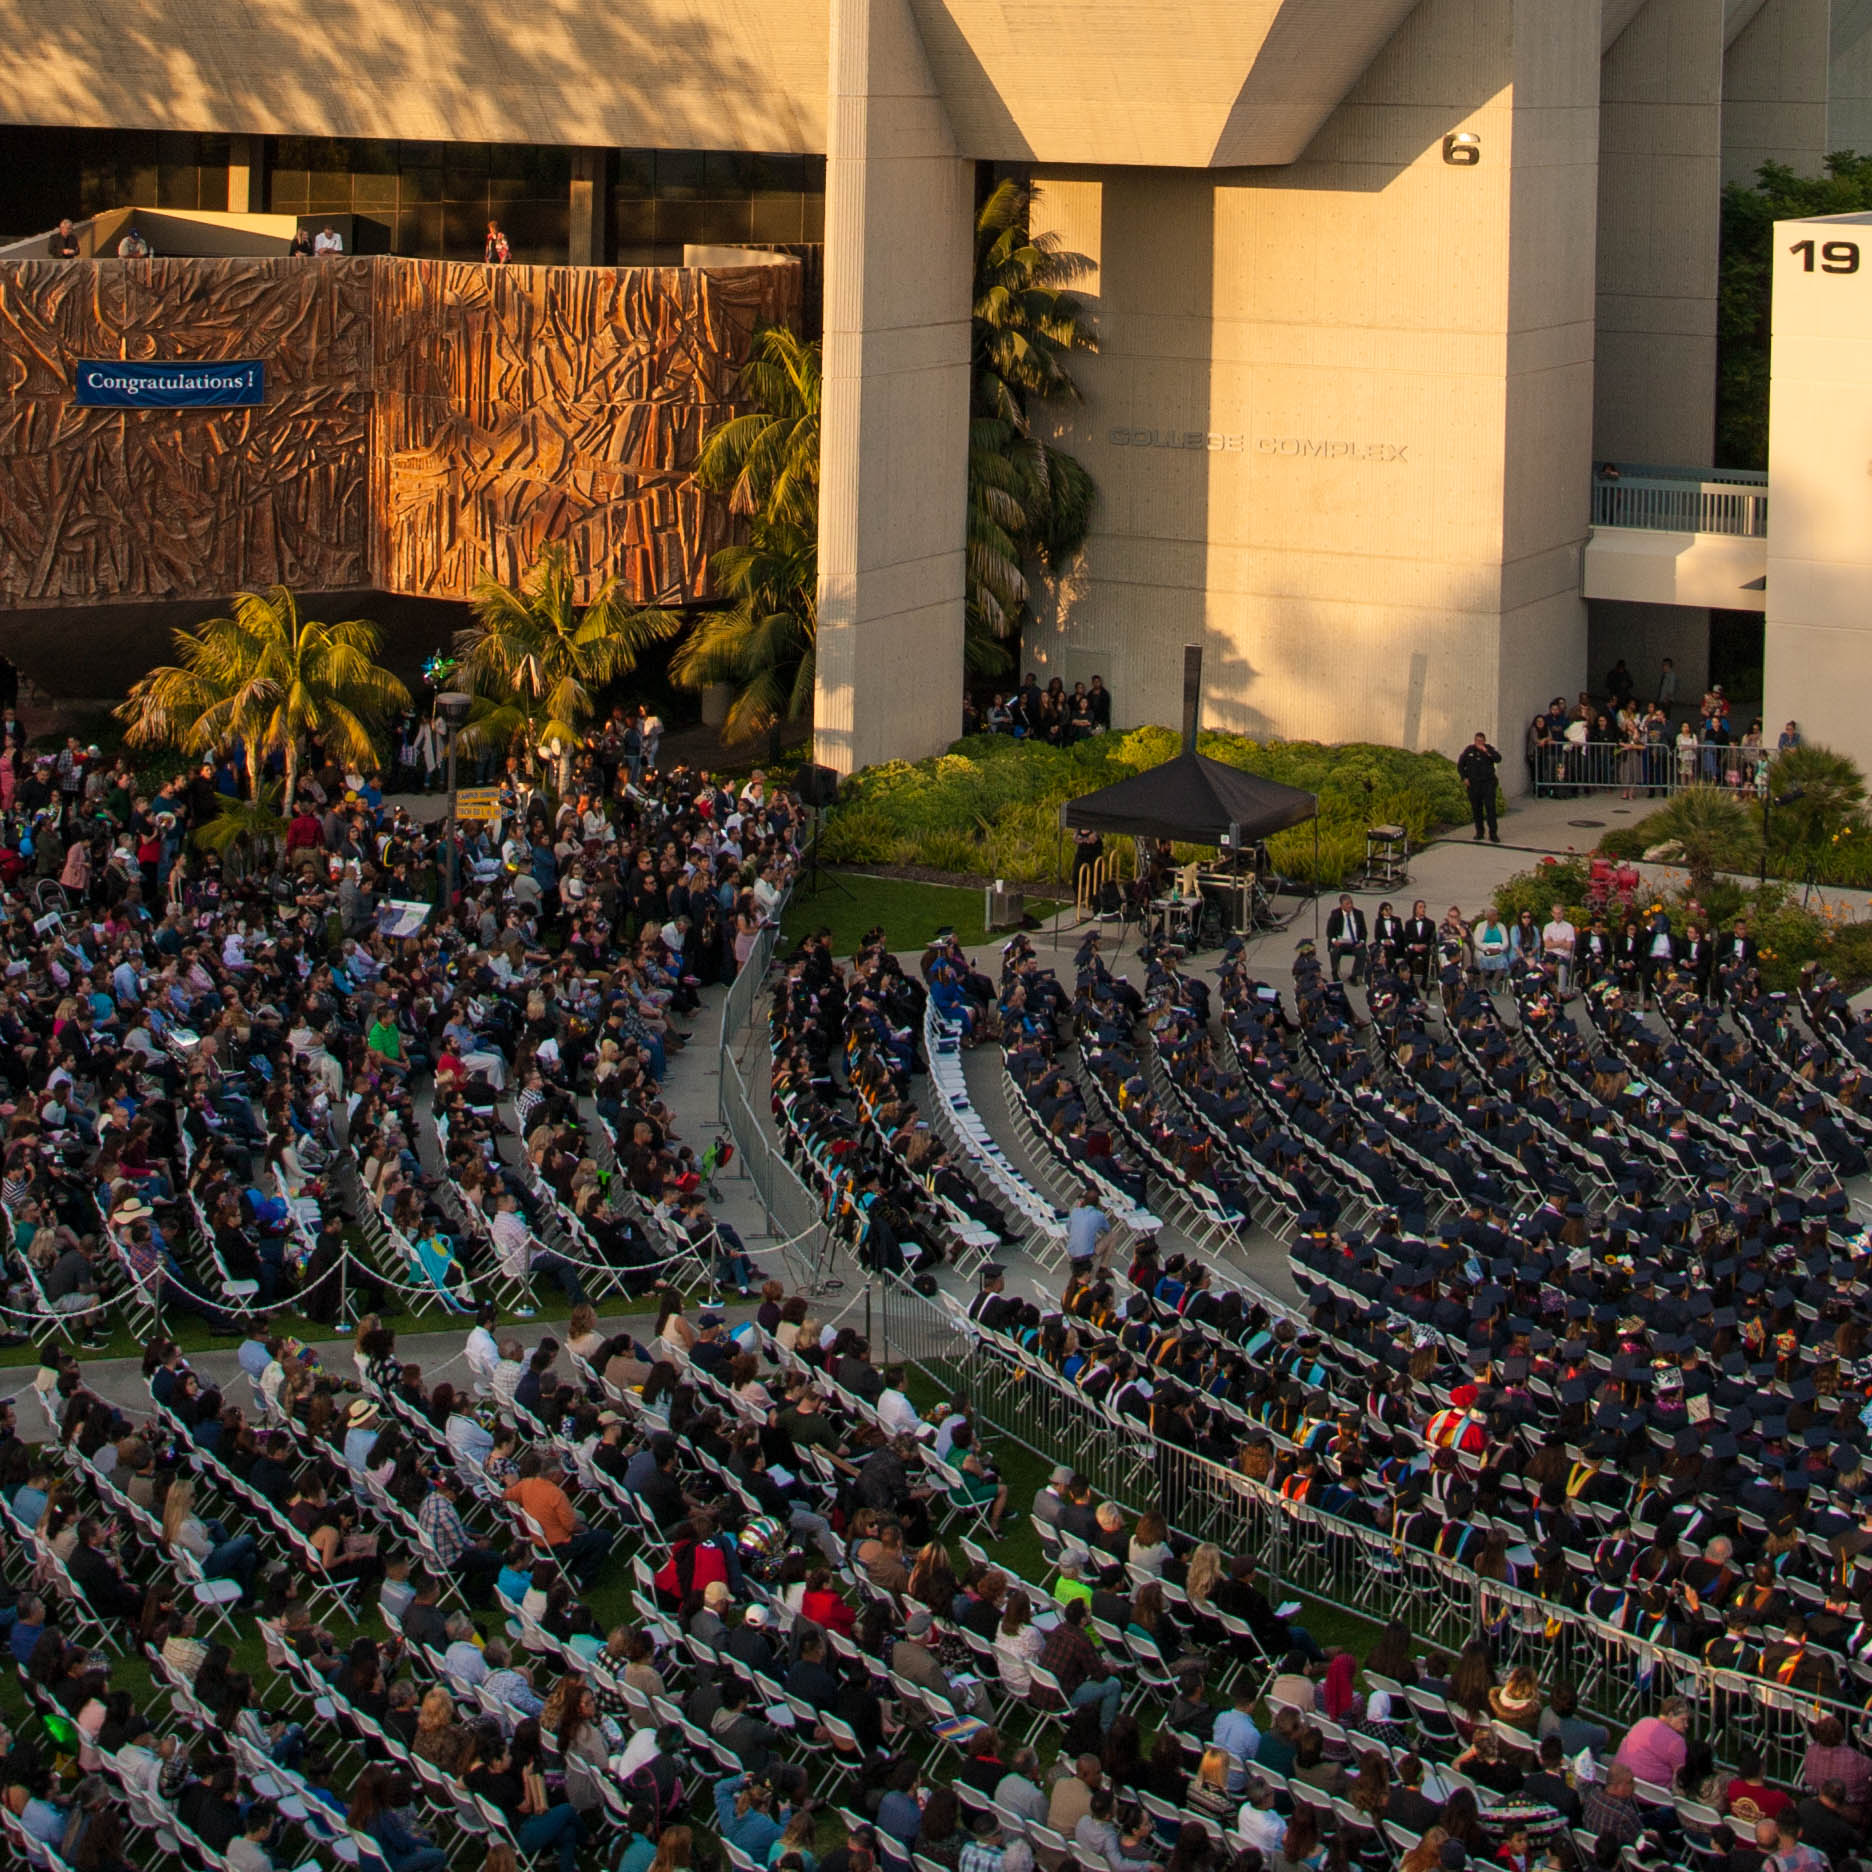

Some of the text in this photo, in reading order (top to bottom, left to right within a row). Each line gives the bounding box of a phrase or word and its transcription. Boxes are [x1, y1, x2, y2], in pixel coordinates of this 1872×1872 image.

[1442, 132, 1481, 166] 6
[1788, 239, 1860, 275] 19
[1109, 429, 1410, 464] COLLEGE COMPLEX
